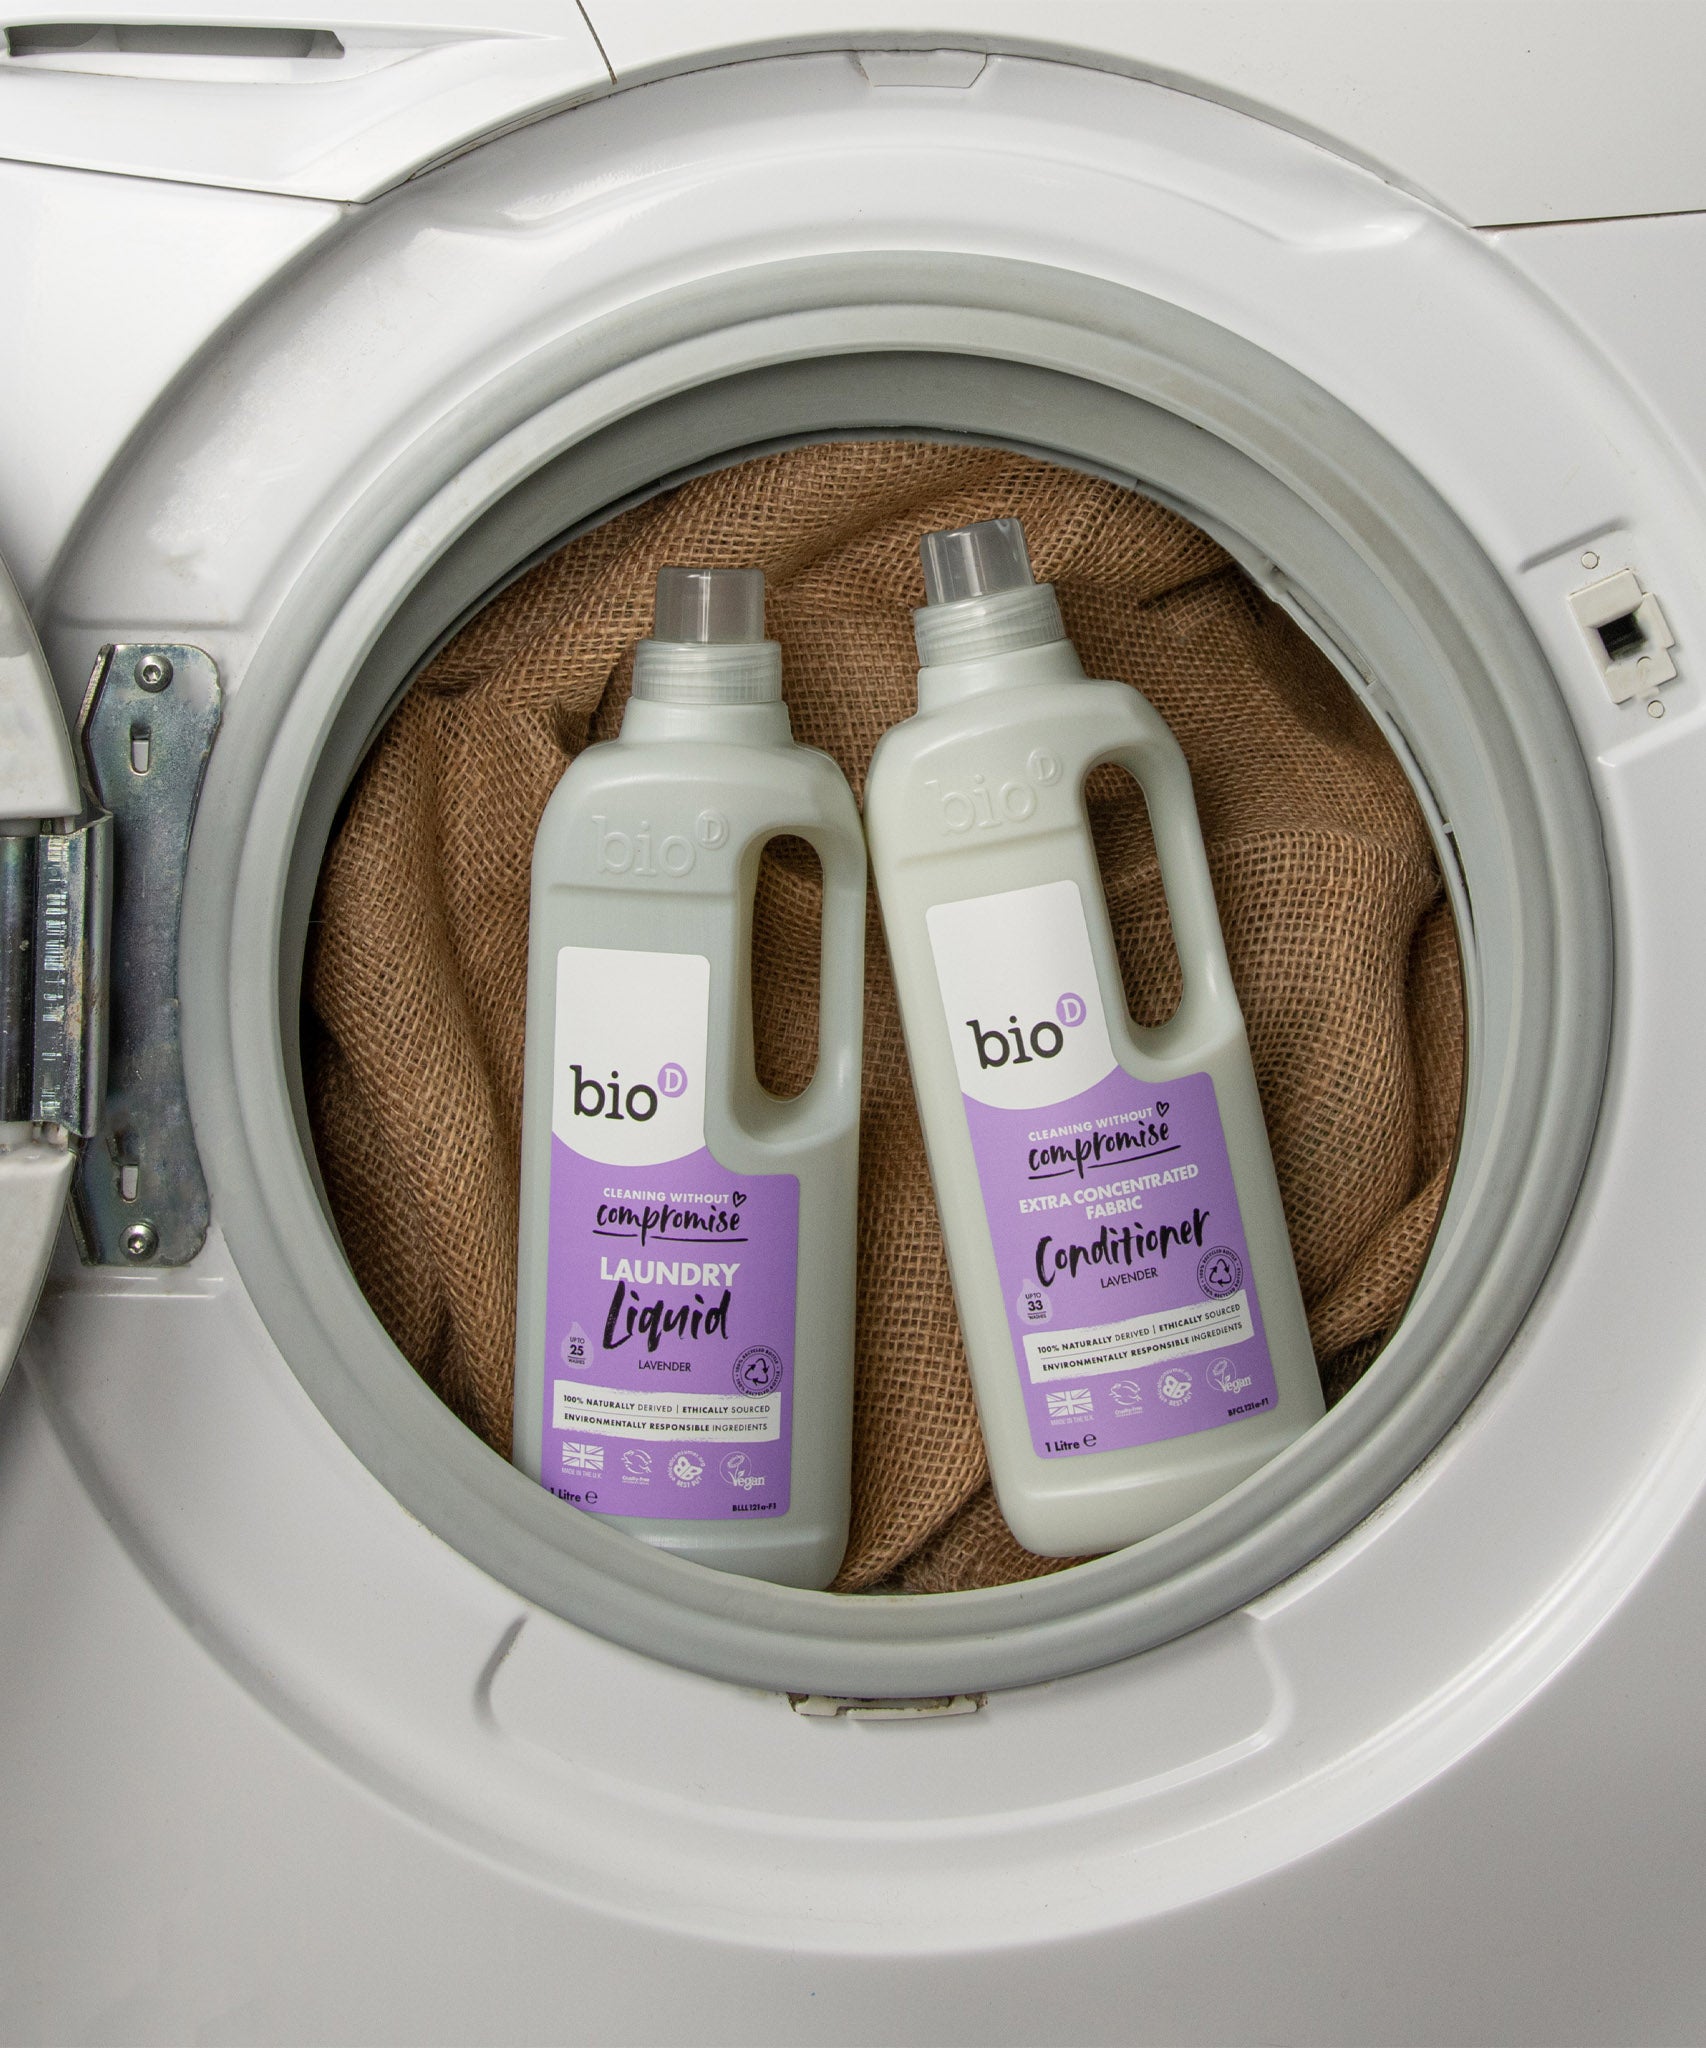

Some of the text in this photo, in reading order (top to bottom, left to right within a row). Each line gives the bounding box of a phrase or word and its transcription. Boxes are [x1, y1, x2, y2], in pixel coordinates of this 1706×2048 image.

[1028, 1107, 1153, 1142] CLEANING WITHOUT
[1028, 1120, 1170, 1179] compromise
[603, 1187, 730, 1204] CLEANING WITHOUT
[1019, 1163, 1199, 1214] EXTRA CONCENTRATED
[1085, 1195, 1143, 1220] FABRIC
[597, 1203, 741, 1247] compromise
[1035, 1208, 1210, 1287] Conditioner
[600, 1256, 741, 1287] LAUNDRY
[1100, 1267, 1158, 1289] LAVENDER
[602, 1280, 732, 1352] Liquid
[1027, 1299, 1044, 1312] 33
[1037, 1303, 1241, 1354] 100% NATURALLY DERIVED ETHICALLY SOURCED
[569, 1344, 585, 1356] 25
[1042, 1321, 1243, 1372] ENVIRONMENTALLY RESPONSIBLE INGREDIENTS
[638, 1360, 692, 1372] LAVENDER
[563, 1394, 771, 1414] 100% NATURALLY DERIVED ETHICALLY SOURCED
[564, 1412, 768, 1432] ENVIRONMENTALLY RESPONSIBLE INGREDIENTS
[1045, 1441, 1052, 1453] 1
[1054, 1440, 1080, 1452] Litre
[558, 1489, 581, 1502] Litre
